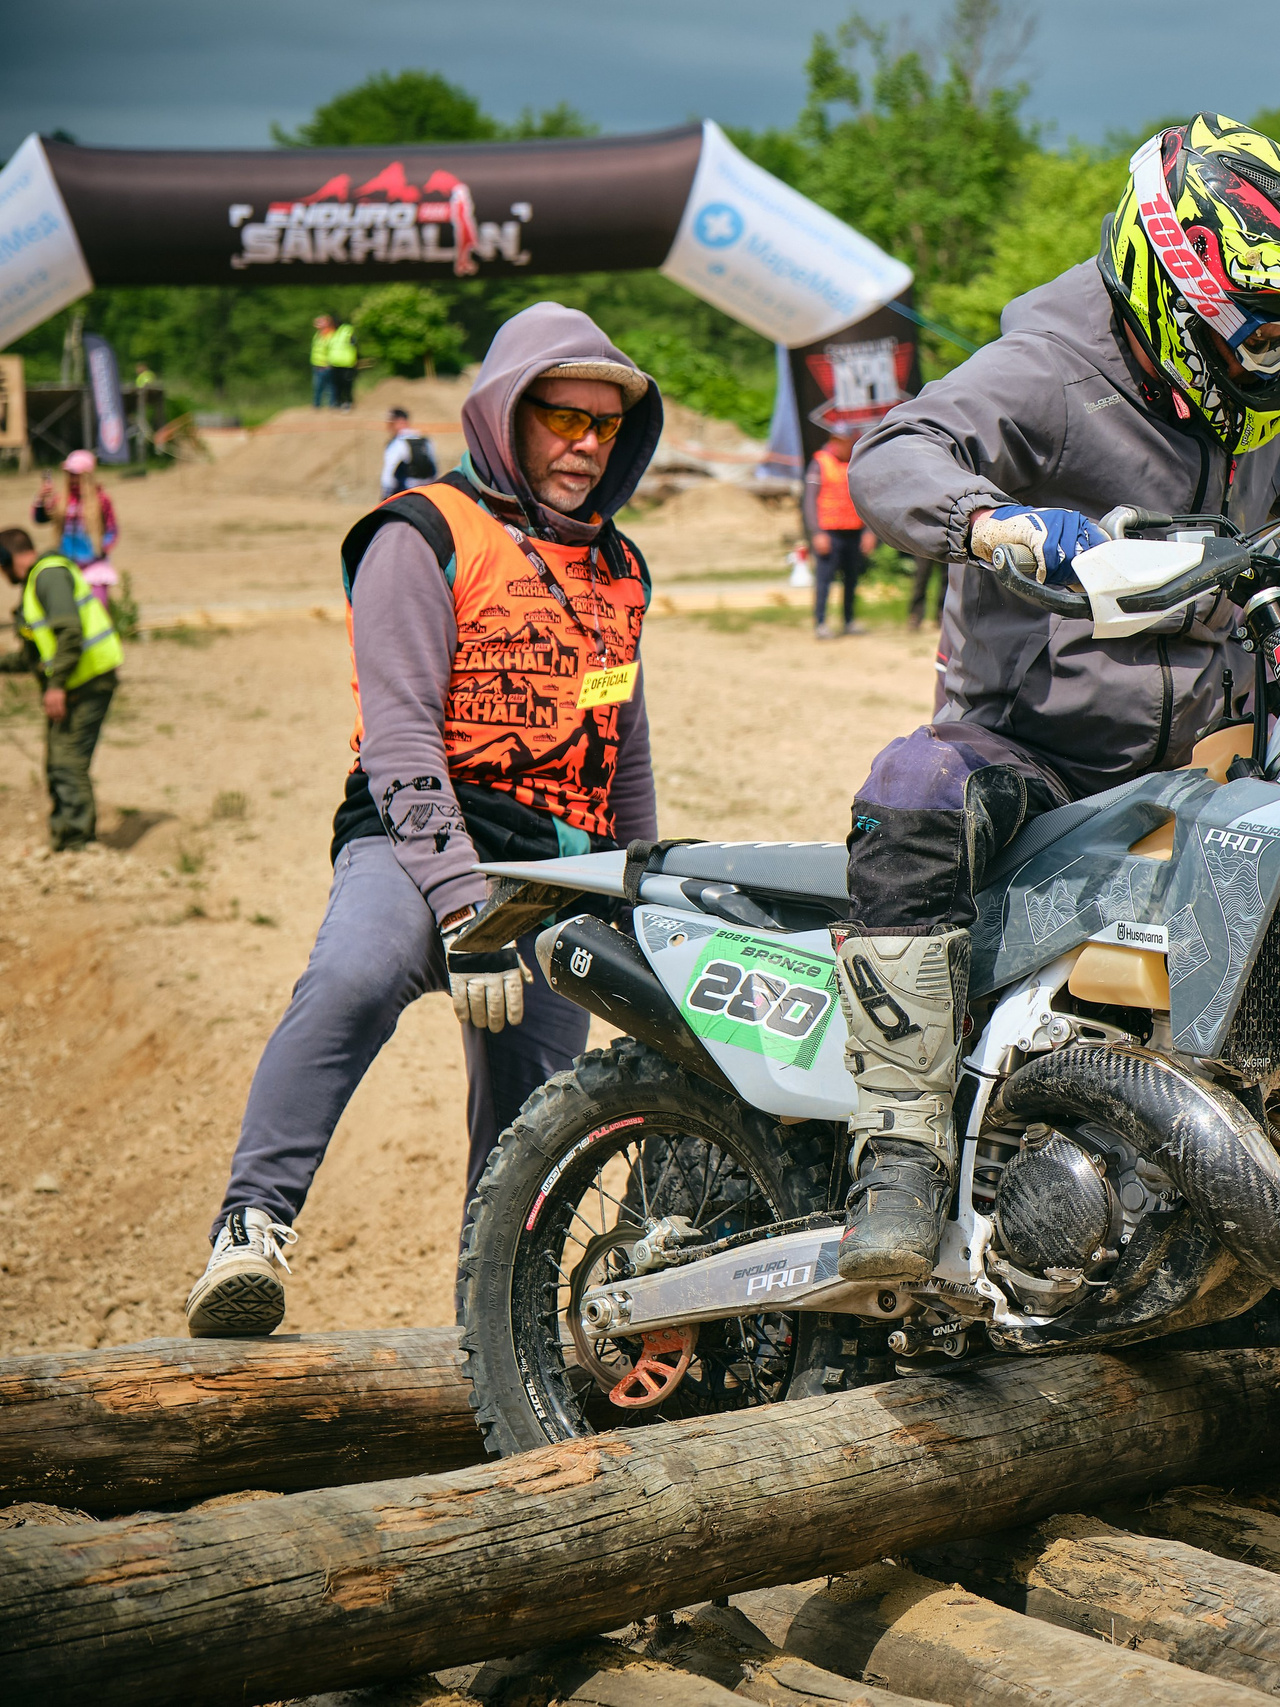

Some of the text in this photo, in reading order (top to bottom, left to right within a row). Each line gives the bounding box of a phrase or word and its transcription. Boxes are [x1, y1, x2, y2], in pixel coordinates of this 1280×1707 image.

[264, 202, 418, 229] ENDURO
[1140, 193, 1235, 317] 100%
[461, 641, 534, 653] ENDURO
[591, 671, 629, 690] OFFICIAL
[449, 692, 506, 704] NDURO
[445, 700, 554, 728] AKHALIN
[1203, 827, 1264, 855] PRO
[1126, 928, 1164, 945] Husqvarna
[685, 958, 832, 1041] 280
[733, 1259, 788, 1280] ENDURO
[747, 1265, 812, 1296] PRO
[525, 1378, 547, 1420] EXCEL
